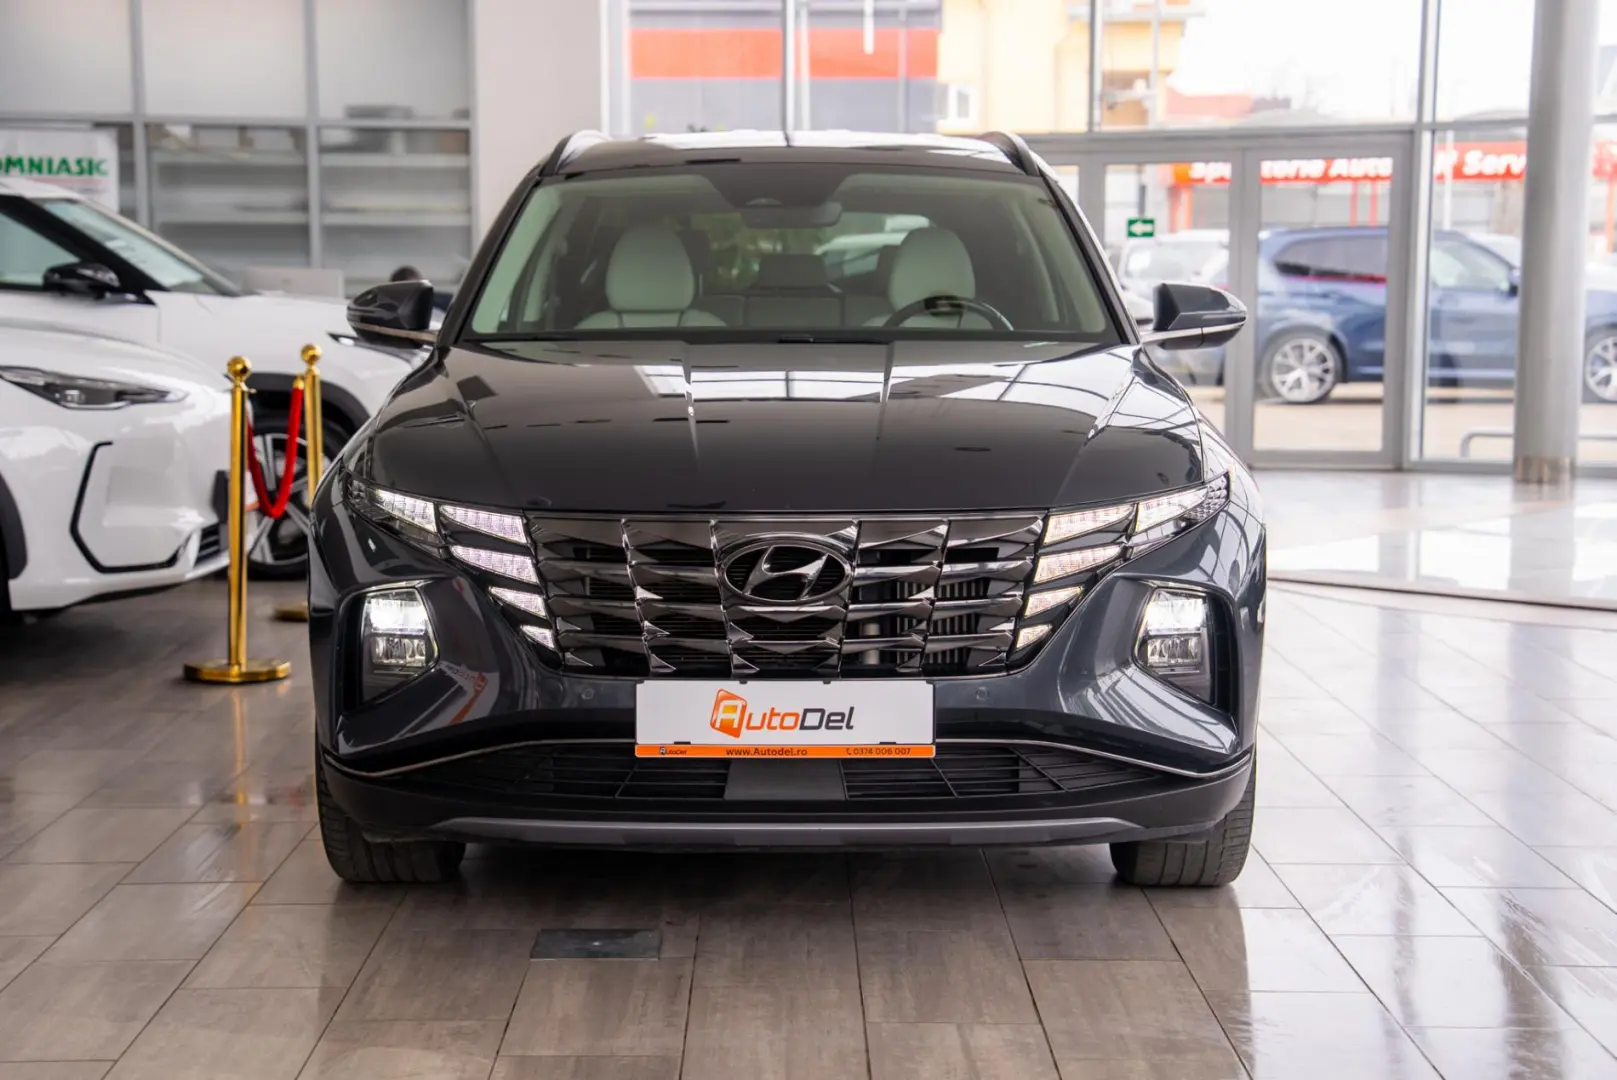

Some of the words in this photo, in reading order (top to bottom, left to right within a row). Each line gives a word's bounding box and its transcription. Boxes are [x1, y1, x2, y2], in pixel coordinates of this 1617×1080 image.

[1463, 150, 1527, 176] Serv
[711, 694, 855, 735] AutoDel
[726, 747, 808, 756] www.Autodel.ro
